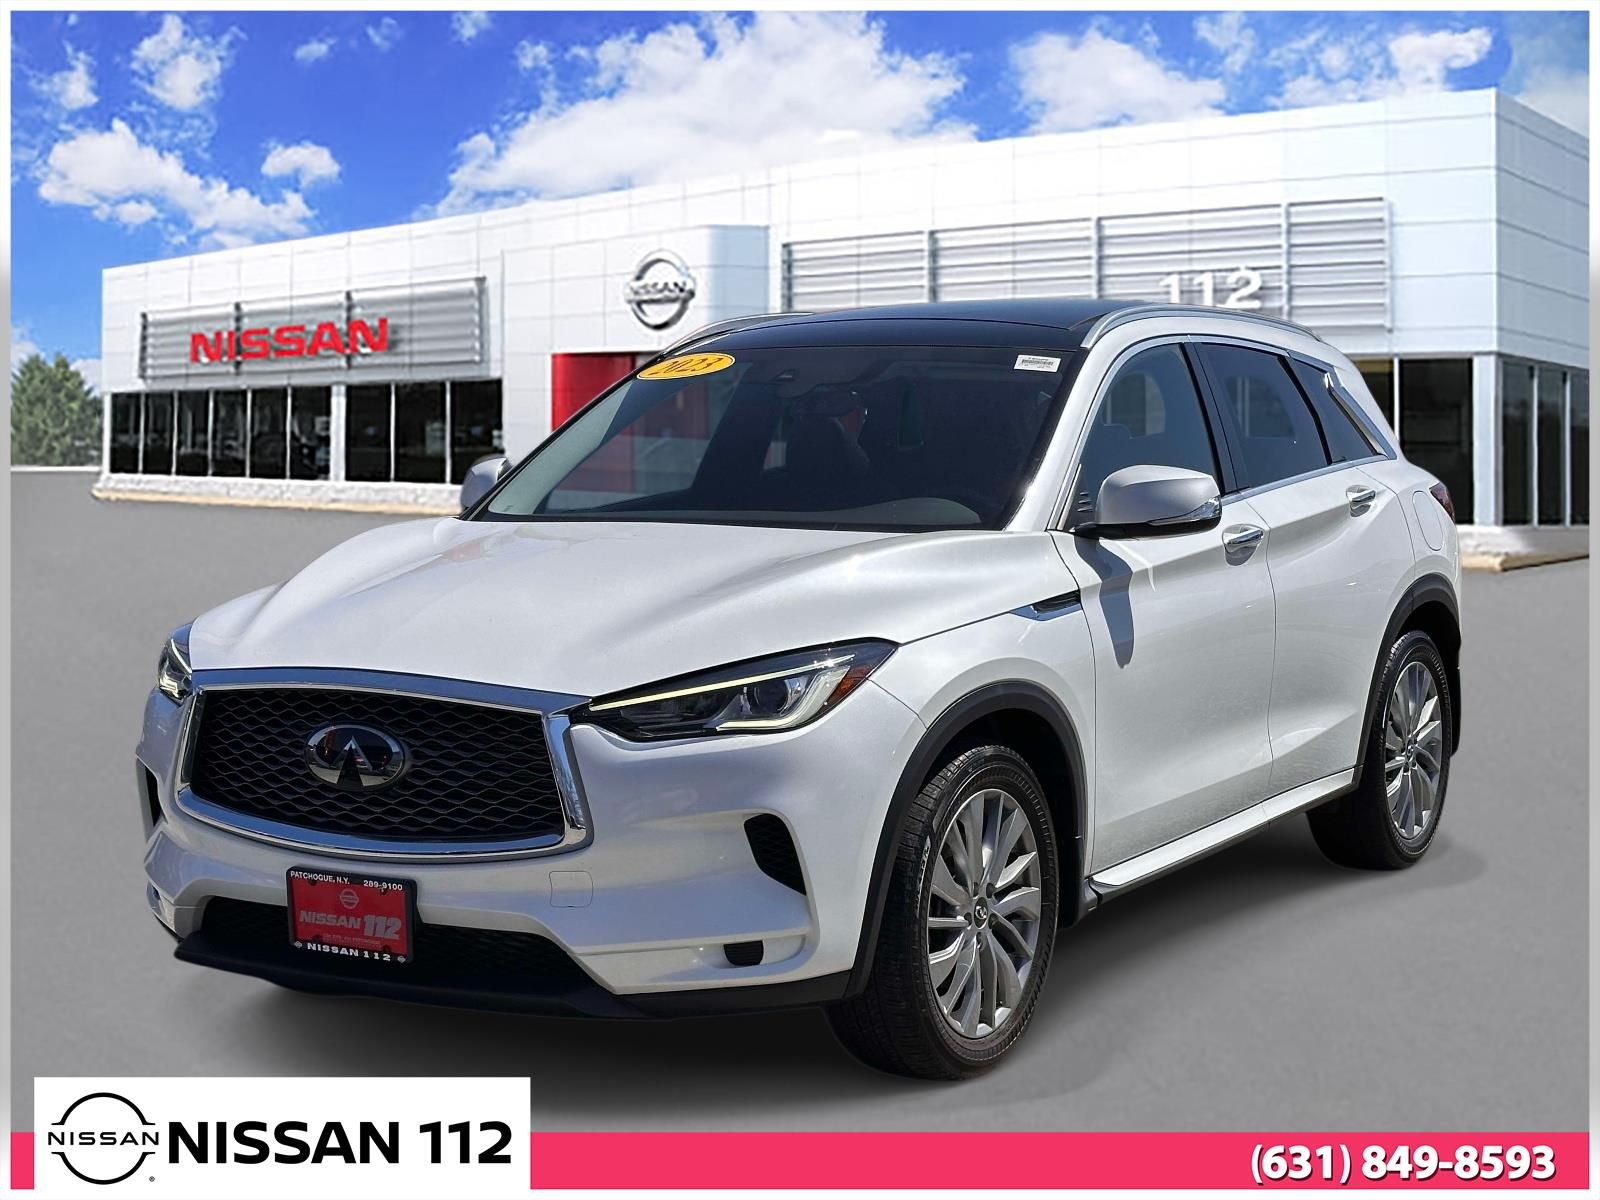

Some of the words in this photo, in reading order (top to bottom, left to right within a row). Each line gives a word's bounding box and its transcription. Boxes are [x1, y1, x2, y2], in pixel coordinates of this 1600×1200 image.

[1159, 270, 1262, 309] 112
[190, 317, 389, 363] NISSAN
[648, 357, 724, 376] 2023
[363, 879, 403, 891] 289-9100
[300, 910, 361, 929] NISSAN
[363, 914, 402, 940] 112
[306, 942, 359, 957] NISSAN
